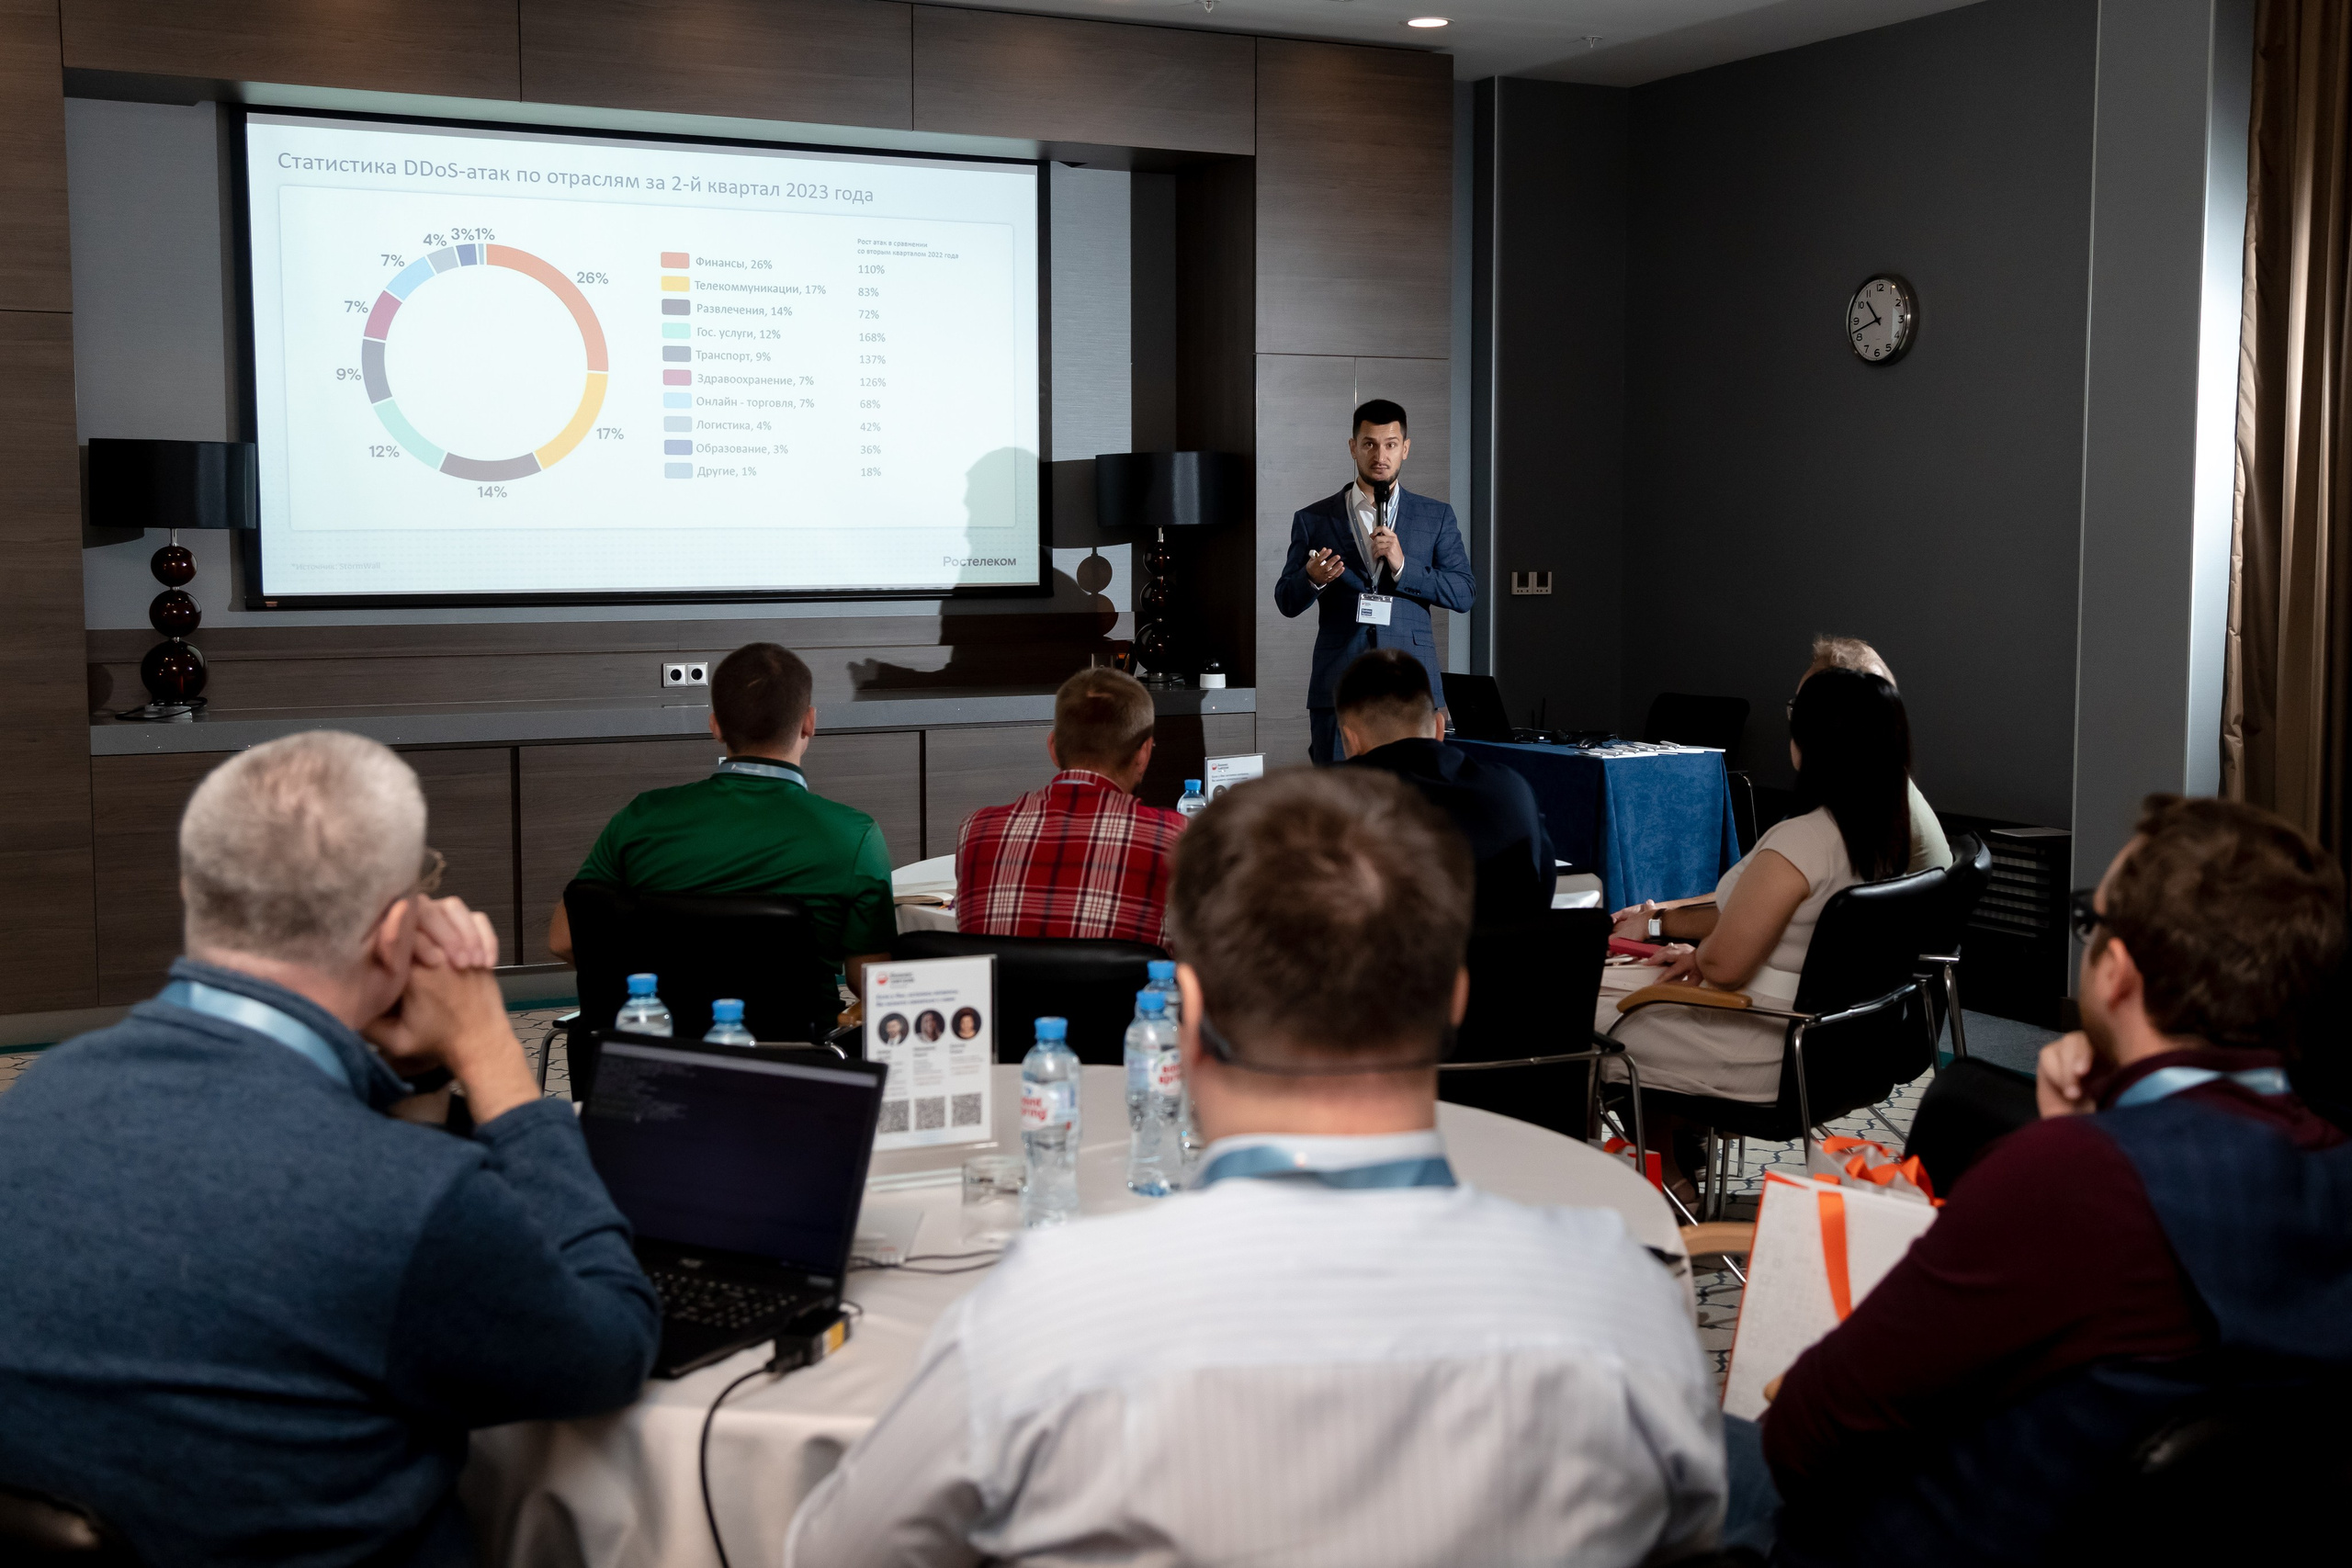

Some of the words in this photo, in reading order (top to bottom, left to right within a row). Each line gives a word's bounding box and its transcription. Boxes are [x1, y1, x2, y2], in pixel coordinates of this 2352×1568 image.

[278, 152, 396, 175] Статистика
[405, 159, 510, 182] DDoS-атак
[517, 170, 541, 184] по
[547, 171, 640, 189] отраслям
[645, 177, 665, 191] за
[672, 175, 701, 192] 2-й
[707, 180, 780, 198] квартал
[786, 182, 829, 199] 2023
[835, 188, 874, 205] года
[451, 227, 474, 241] 3%
[474, 227, 496, 240] 1%
[423, 233, 447, 248] 4%
[381, 254, 405, 267] 7%
[696, 257, 747, 270] Финансы,
[751, 259, 772, 270] 26%
[858, 264, 885, 274] 110%
[576, 271, 609, 285] 26%
[694, 281, 802, 295] Телекоммуникации,
[805, 284, 826, 294] 17%
[858, 287, 879, 297] 83%
[1866, 289, 1871, 298] 11
[1877, 283, 1884, 292] 12
[344, 300, 369, 314] 7%
[1895, 299, 1901, 307] 2
[697, 304, 768, 317] Развлечения,
[771, 306, 792, 316] 14%
[859, 309, 880, 319] 72%
[1898, 315, 1904, 323] 3
[697, 327, 716, 337] Гос.
[719, 329, 757, 340] услуги,
[759, 329, 781, 339] 12%
[859, 332, 886, 342] 168%
[1874, 349, 1880, 357] 6
[1885, 344, 1891, 352] 5
[695, 350, 753, 362] Транспорт,
[756, 351, 771, 361] 9%
[859, 355, 886, 364] 137%
[336, 367, 362, 381] 9%
[697, 373, 796, 387] Здравоохранение,
[798, 376, 814, 385] 7%
[860, 377, 886, 387] 126%
[696, 396, 737, 406] Онлайн
[746, 399, 796, 409] торговля,
[799, 398, 814, 408] 7%
[859, 399, 881, 409] 68%
[696, 420, 754, 431] Логистика,
[757, 420, 772, 430] 4%
[860, 422, 881, 432] 42%
[596, 427, 625, 440] 17%
[368, 445, 400, 458] 12%
[696, 443, 770, 455] Образование,
[773, 444, 789, 454] 3%
[860, 444, 882, 454] 36%
[697, 466, 738, 478] Другие,
[741, 466, 757, 476] 1%
[860, 467, 882, 477] 18%
[477, 485, 508, 498] 14%
[943, 556, 1016, 567] Ростелеком
